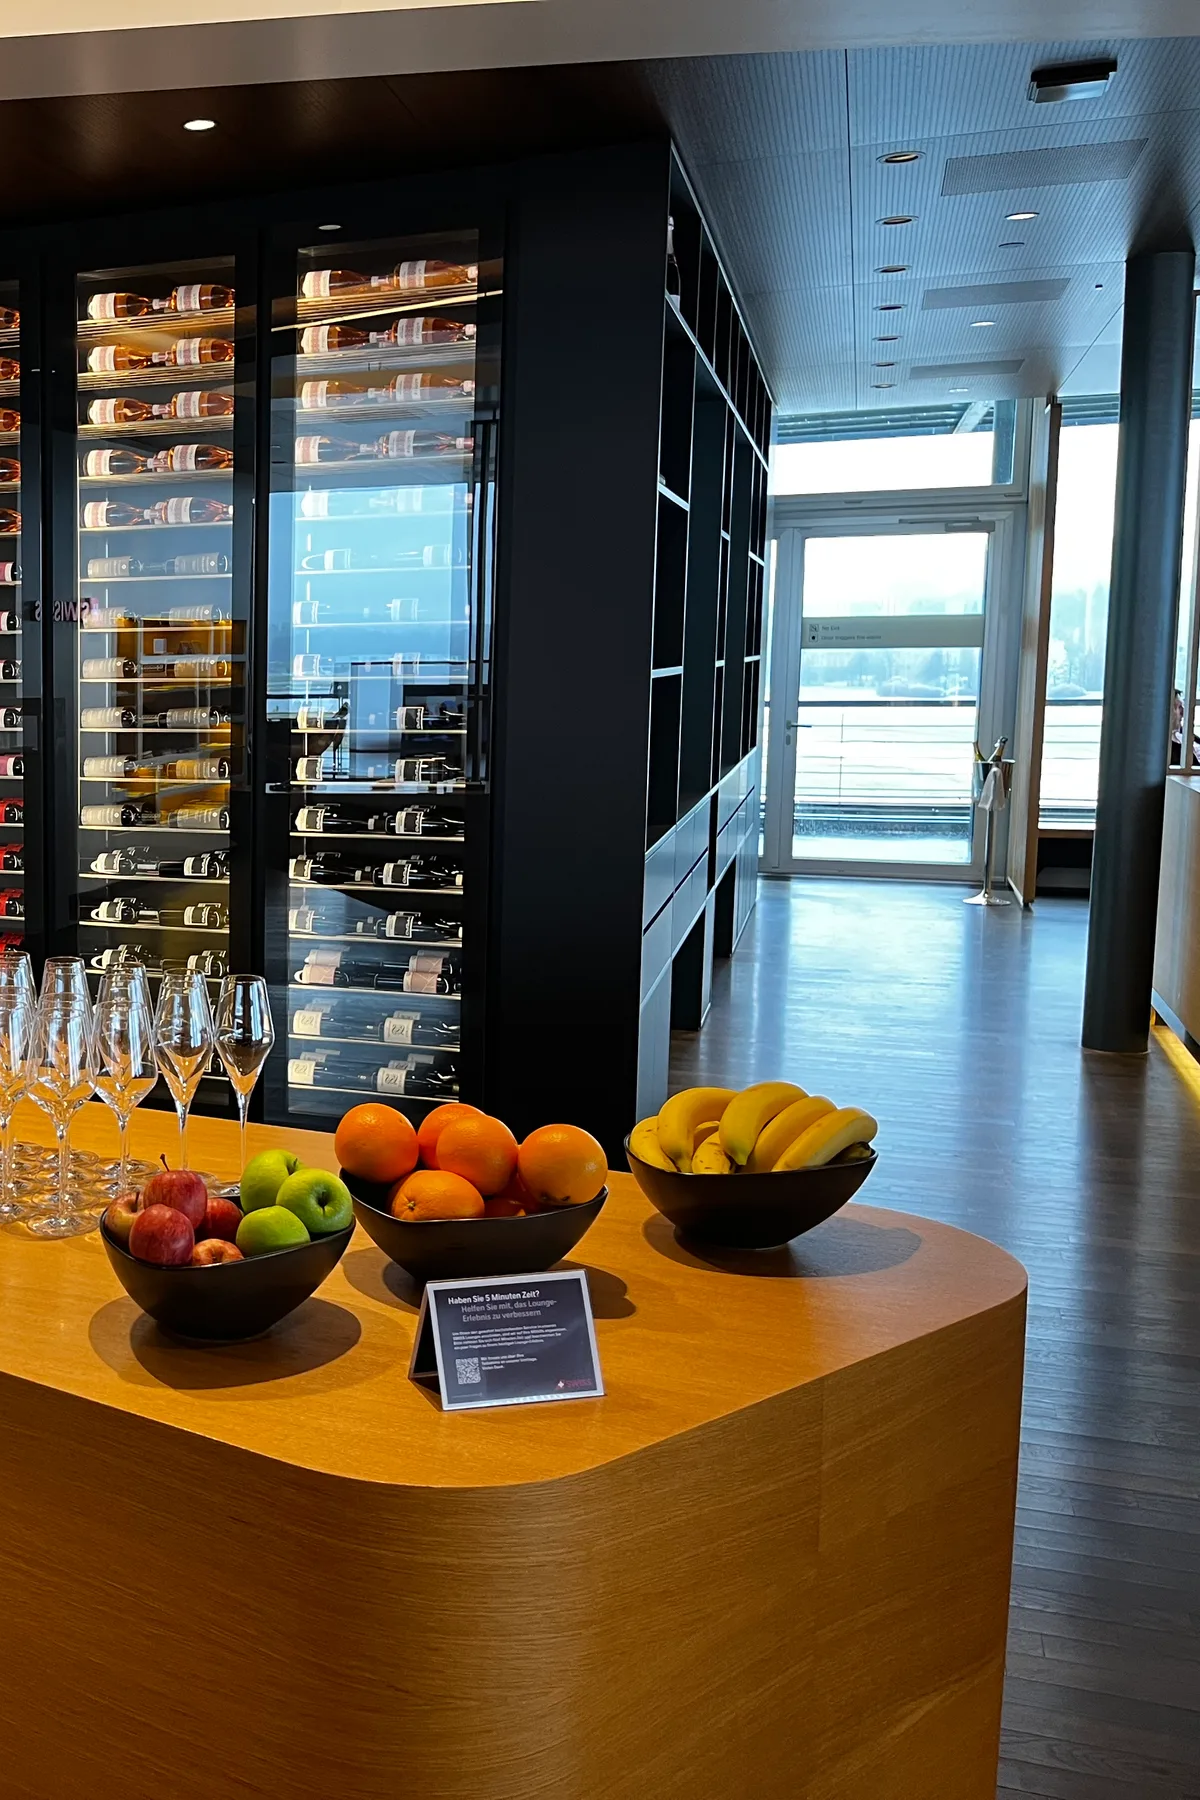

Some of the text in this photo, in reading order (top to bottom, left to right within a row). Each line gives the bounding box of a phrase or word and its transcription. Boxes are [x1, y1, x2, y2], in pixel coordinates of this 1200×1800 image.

[448, 1290, 540, 1304] Haben Sie 5 Minuten Zeit?
[461, 1300, 557, 1313] Helfen Sie mit, das Lounge-
[462, 1313, 491, 1322] Erlebnis
[502, 1310, 541, 1319] verbessern
